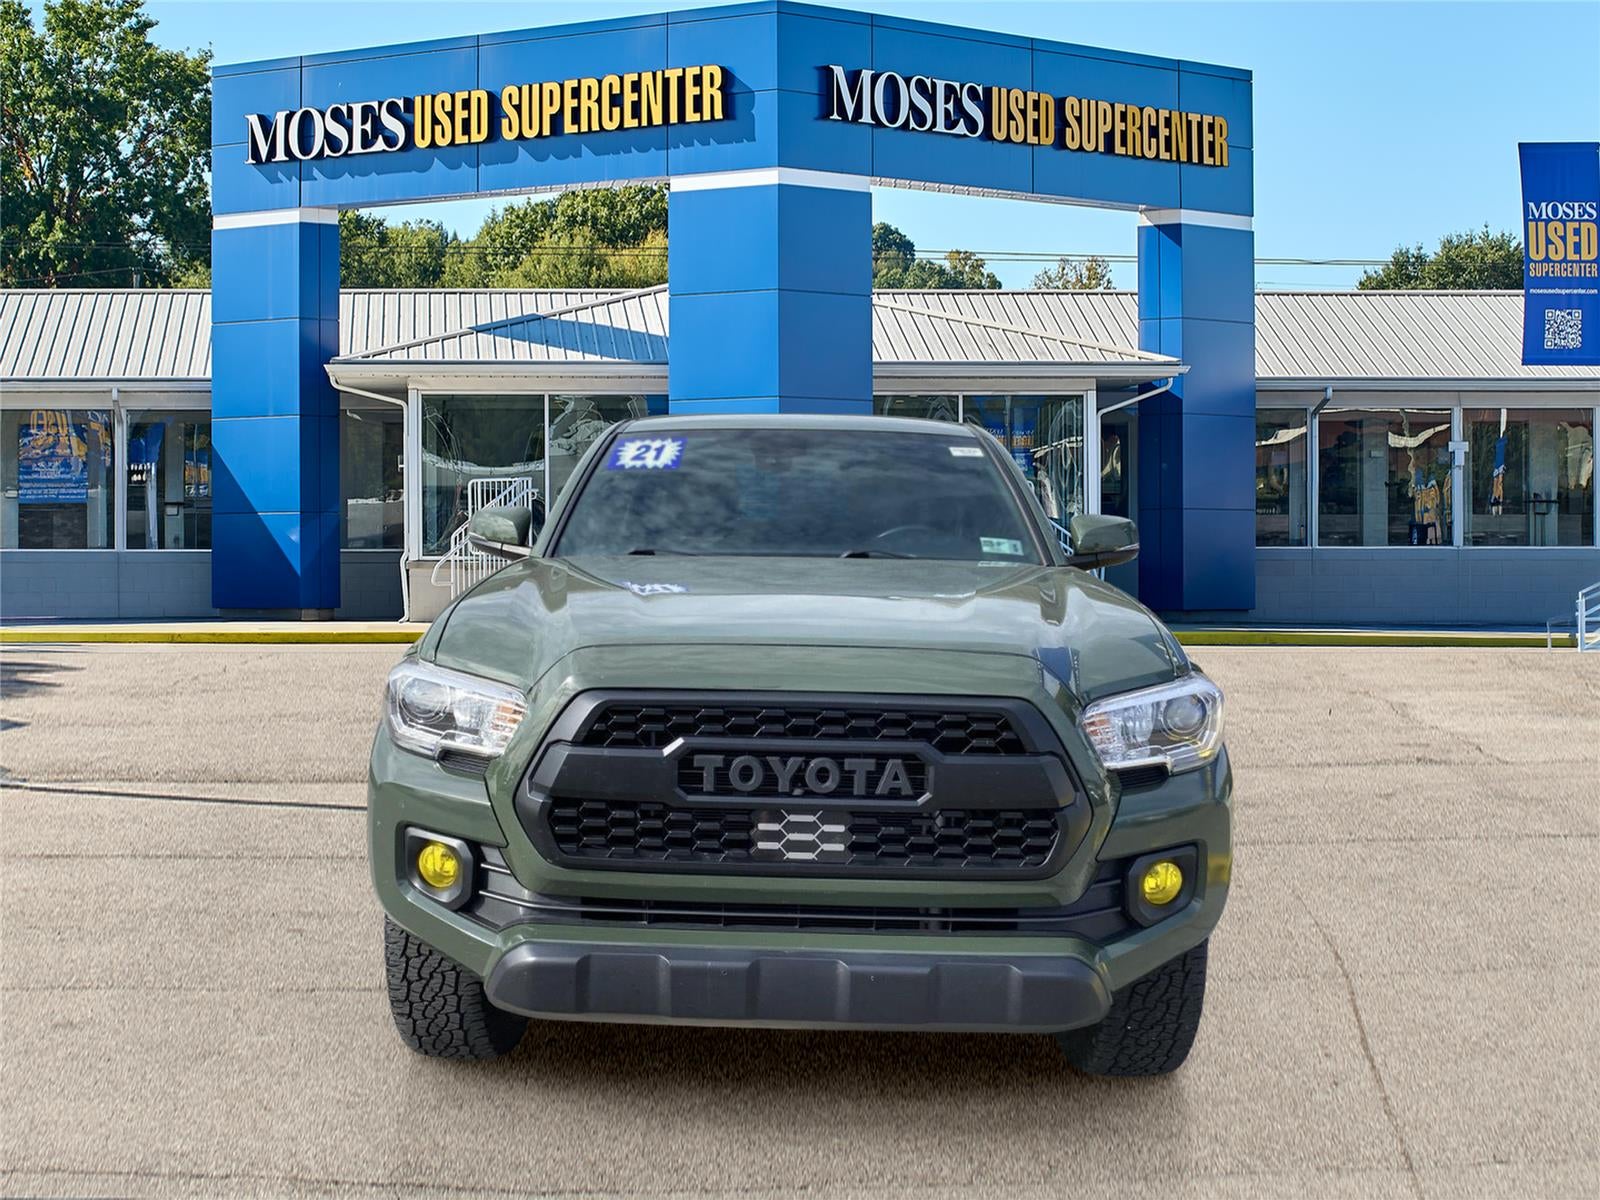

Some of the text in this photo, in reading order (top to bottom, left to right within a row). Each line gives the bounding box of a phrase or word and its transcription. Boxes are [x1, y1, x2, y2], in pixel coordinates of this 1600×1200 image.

[244, 64, 724, 165] MOSES USED SUPERCENTER
[829, 64, 1230, 168] MOSES USED SUPERCENTER
[1528, 202, 1597, 220] MOSES
[1528, 221, 1599, 261] USED
[1529, 263, 1598, 277] SUPERCENTER
[631, 443, 667, 462] 21
[693, 754, 914, 796] TOYOTA
